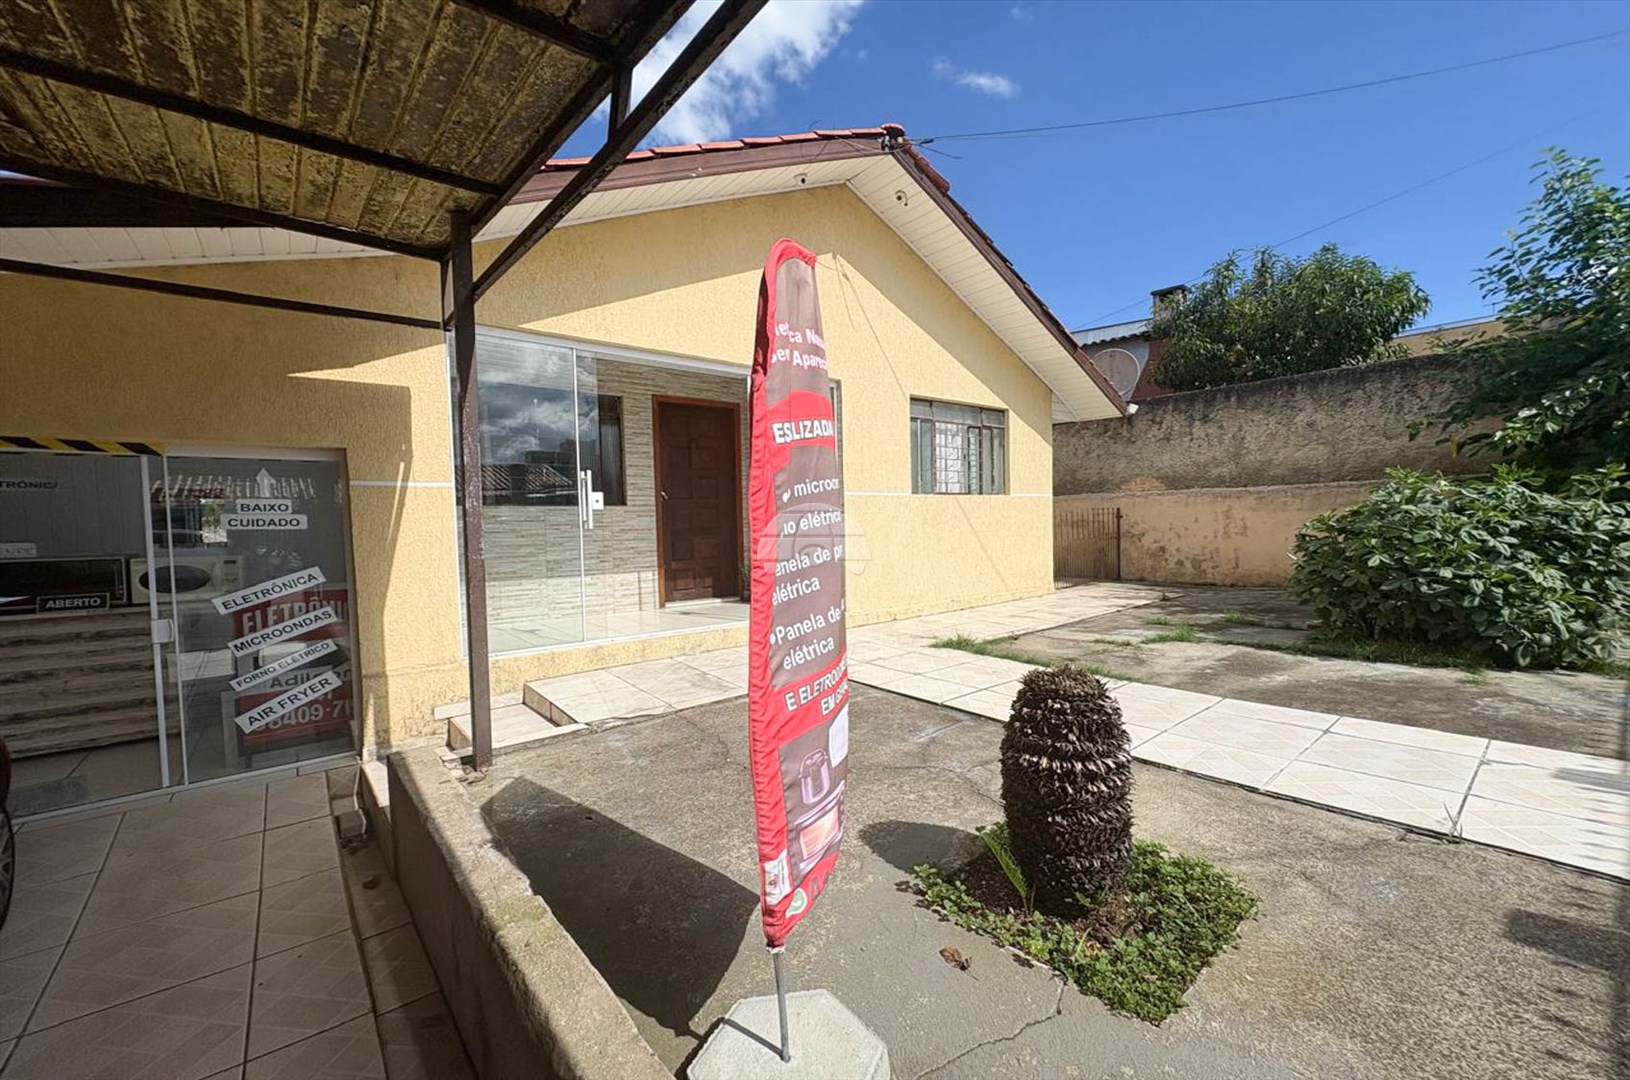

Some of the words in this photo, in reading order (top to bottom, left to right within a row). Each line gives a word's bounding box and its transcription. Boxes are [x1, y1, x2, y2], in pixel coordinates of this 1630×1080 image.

[227, 518, 300, 528] CUIDADO
[240, 503, 289, 513] BAIXO
[813, 547, 831, 564] de
[45, 597, 101, 609] ABERTO
[221, 572, 319, 611] ELETRÔNICA
[771, 576, 821, 606] elétrica
[233, 610, 332, 653] MICROONDAS
[775, 613, 826, 641] Panela
[827, 605, 842, 624] de
[782, 636, 835, 670] elétrica
[235, 666, 277, 688] FORNO
[248, 706, 277, 727] AIR
[277, 678, 334, 710] FRYER
